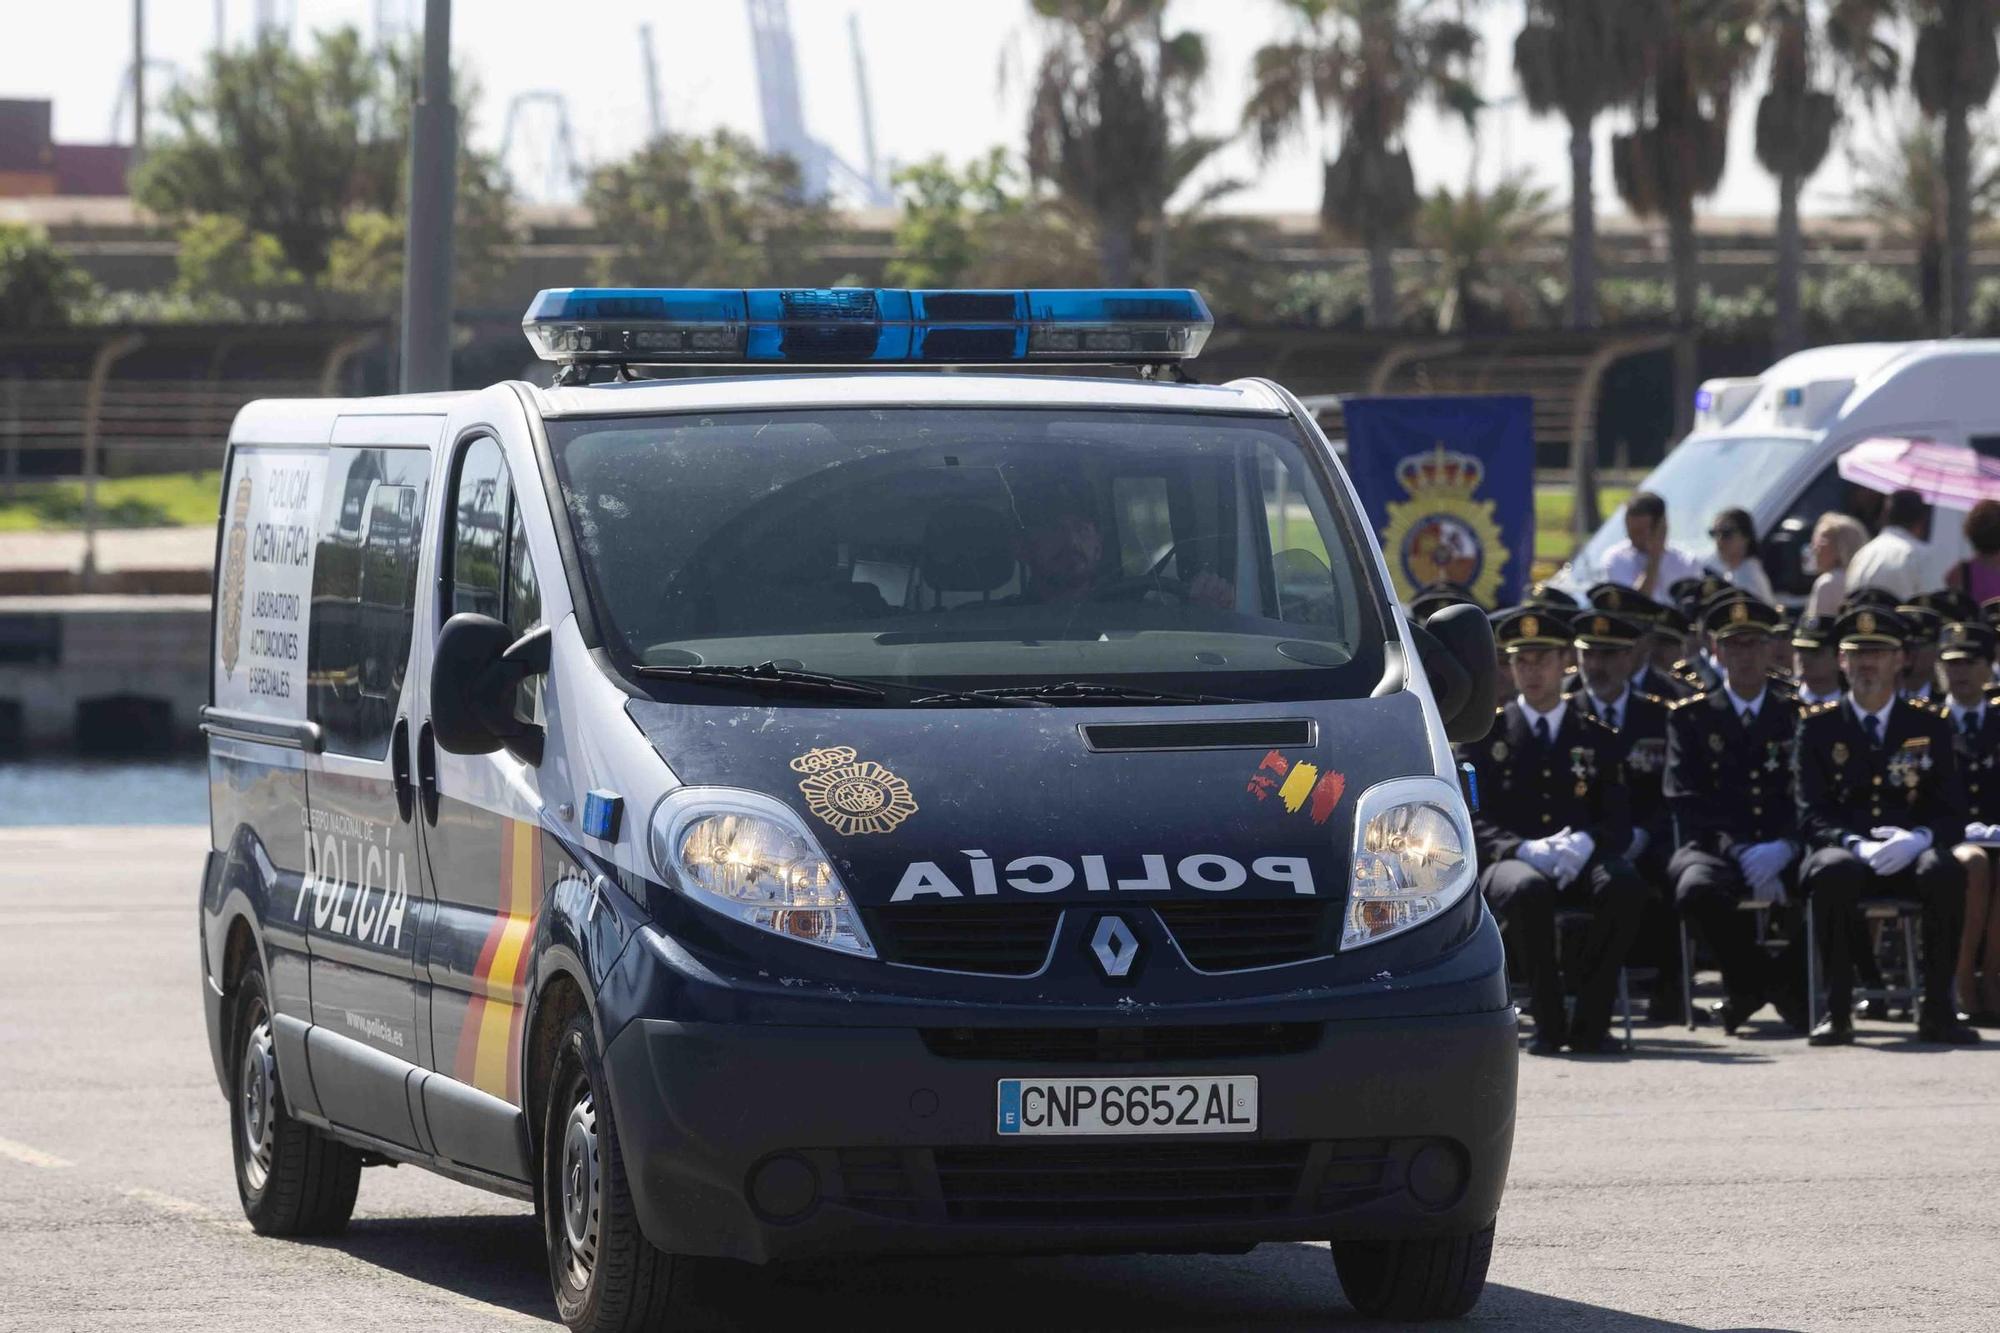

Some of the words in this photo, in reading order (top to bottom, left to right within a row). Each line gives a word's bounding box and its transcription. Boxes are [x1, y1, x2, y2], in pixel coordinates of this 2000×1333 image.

[252, 592, 299, 621] LABORATORIO
[250, 629, 298, 660] ACTUACIONES
[249, 667, 290, 698] ESPECIALES
[301, 806, 329, 831] CUERPO
[330, 812, 363, 839] NACIONAL
[364, 821, 374, 842] DE
[293, 827, 407, 949] POLICÍA
[345, 1011, 404, 1047] www.policia.es
[1005, 1112, 1015, 1124] E
[1021, 1083, 1251, 1127] CNP6652AL
